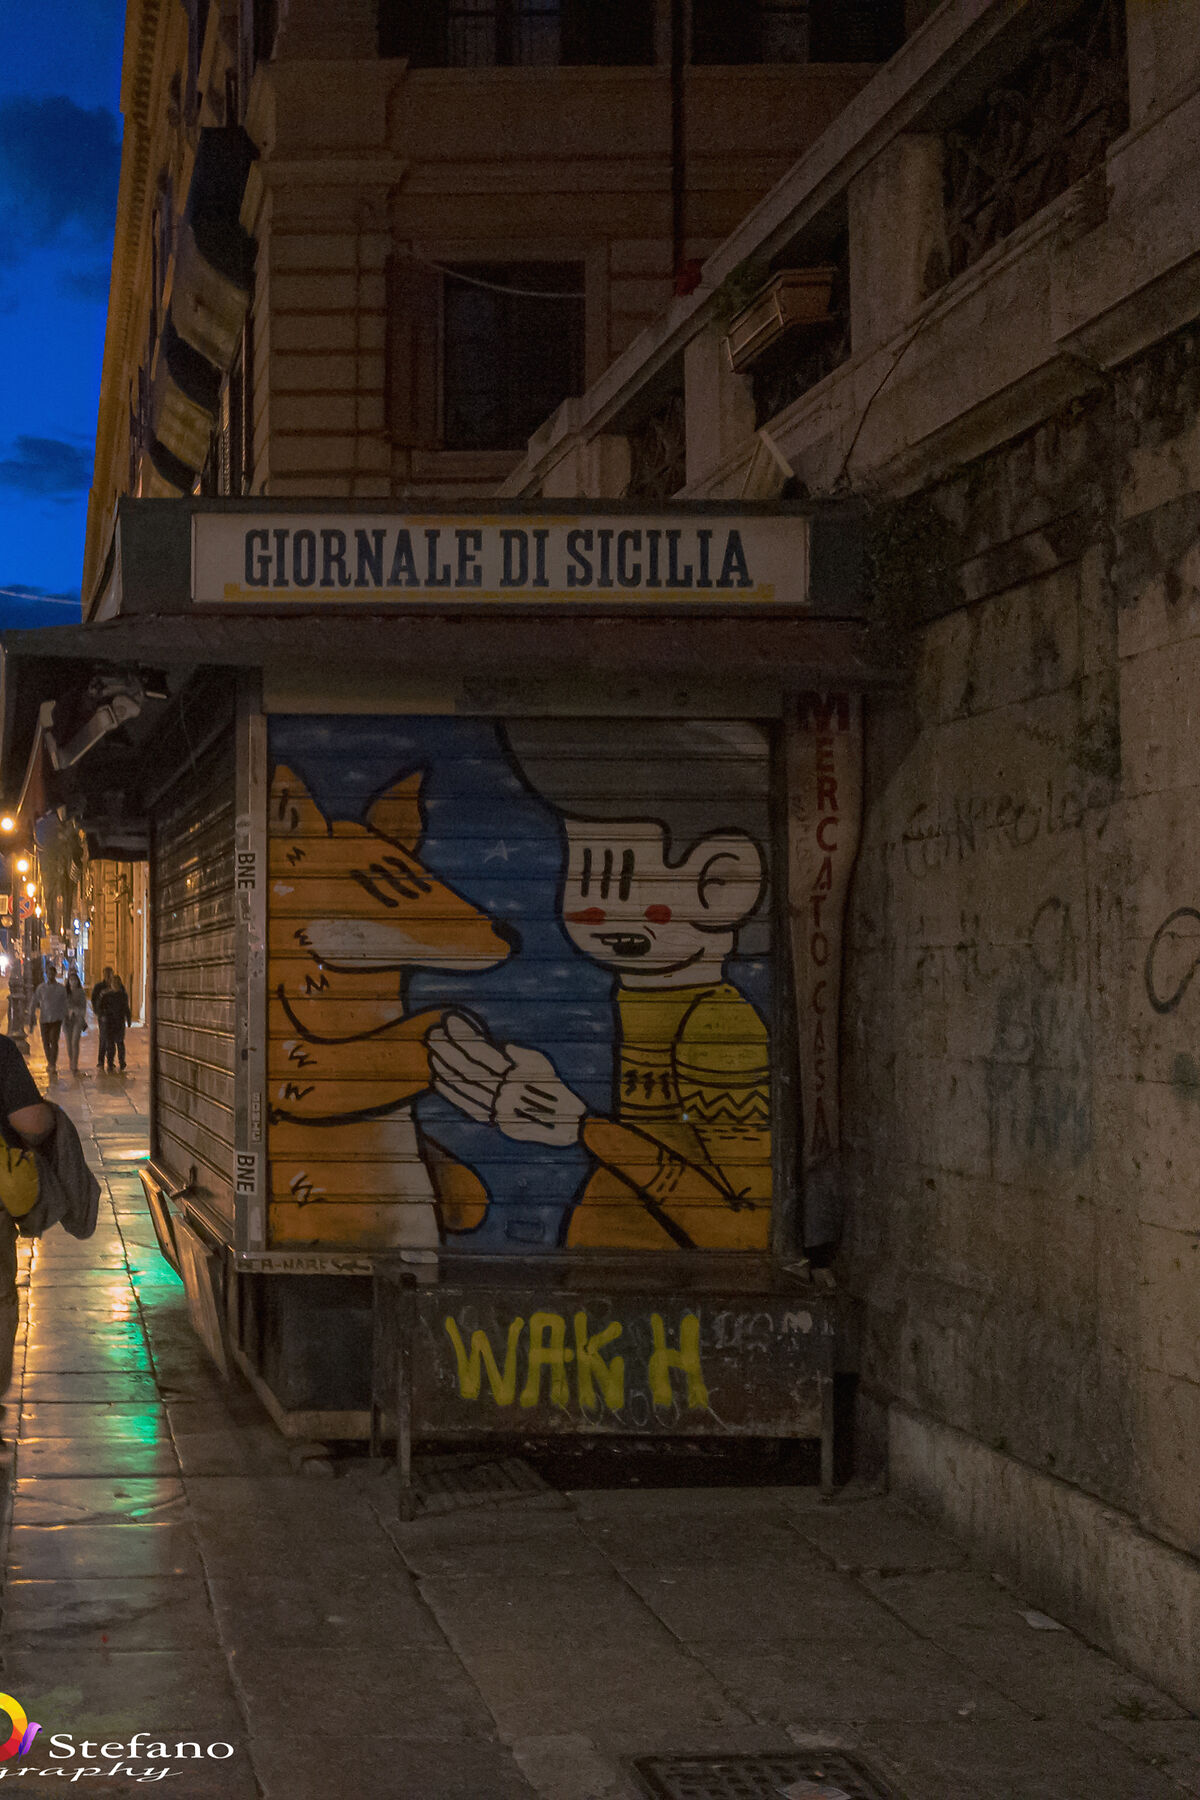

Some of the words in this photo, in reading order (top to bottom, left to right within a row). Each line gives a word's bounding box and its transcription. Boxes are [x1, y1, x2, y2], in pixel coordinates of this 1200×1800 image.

[244, 529, 483, 587] GIORNALE
[499, 529, 550, 587] DI
[566, 529, 754, 588] SICILIA
[236, 852, 256, 890] BNE
[236, 1154, 256, 1193] BNE
[648, 1313, 709, 1409] H
